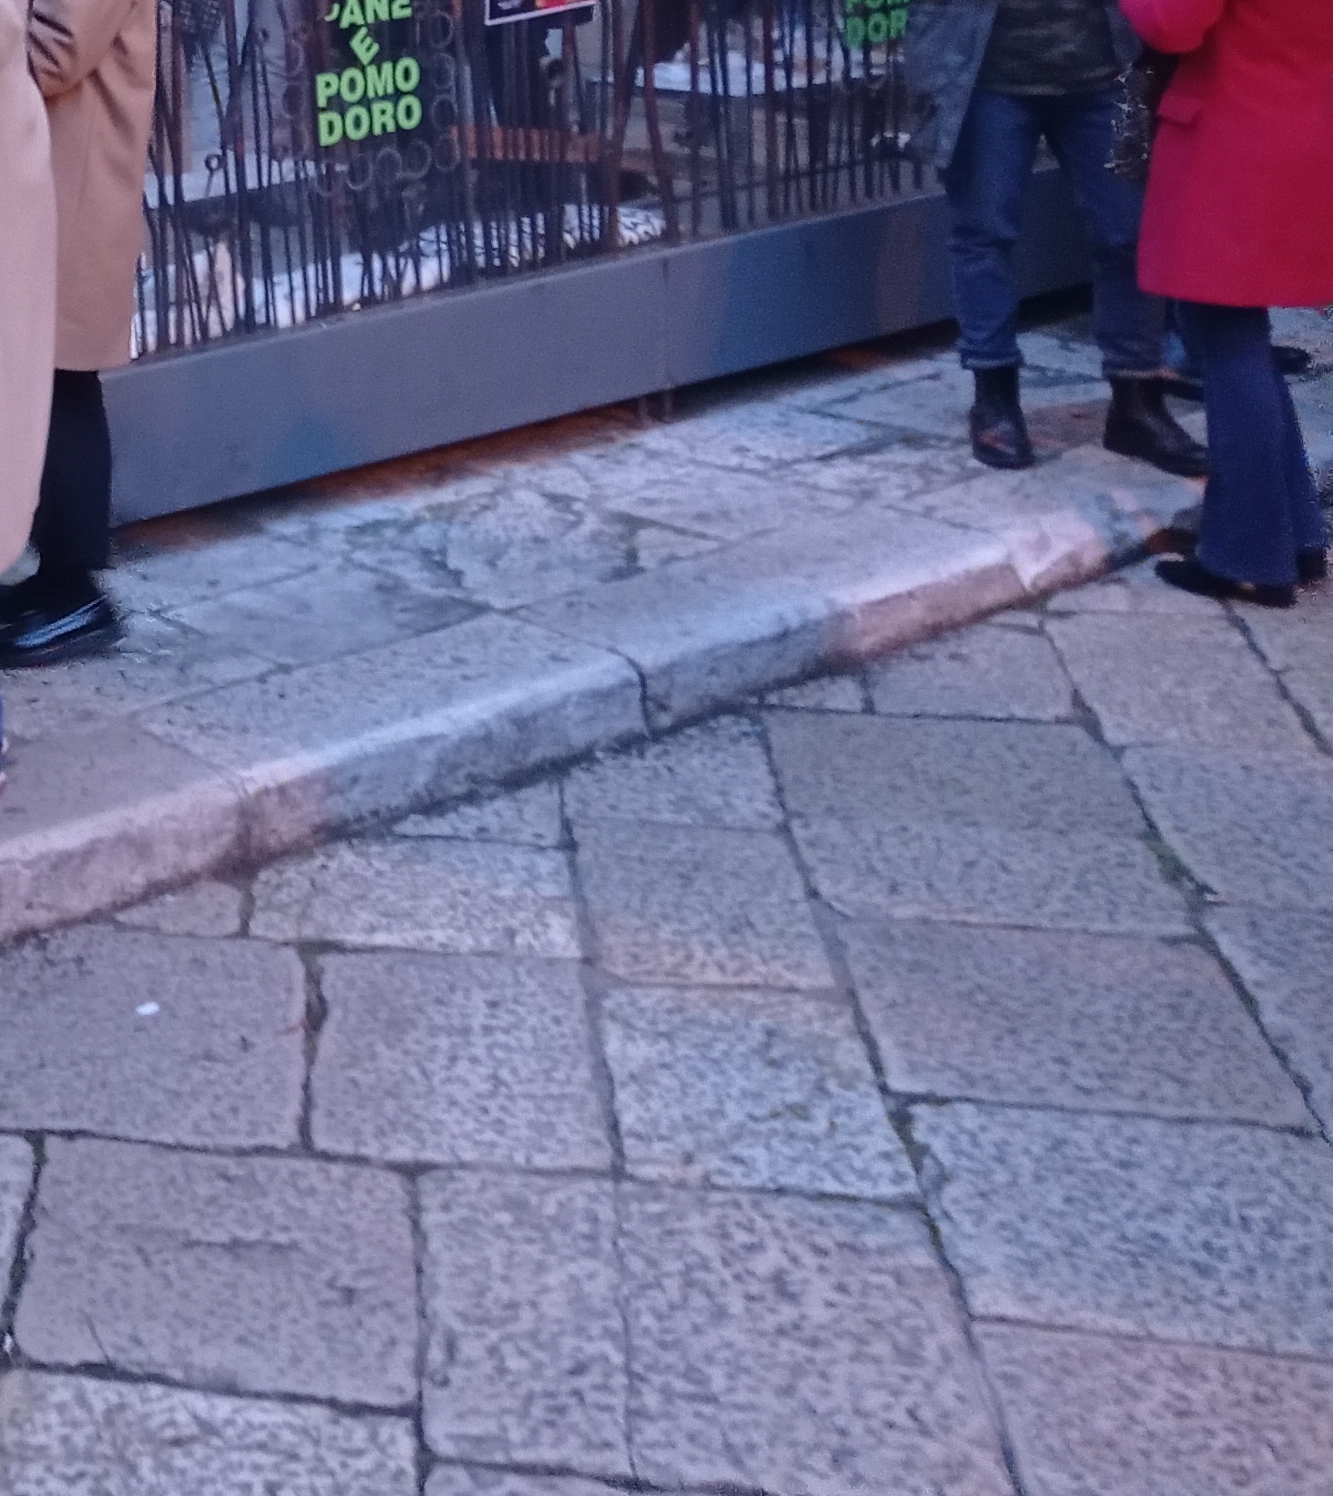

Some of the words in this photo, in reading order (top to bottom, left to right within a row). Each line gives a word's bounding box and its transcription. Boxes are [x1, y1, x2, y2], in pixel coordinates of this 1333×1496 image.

[846, 8, 909, 47] DOR
[316, 57, 421, 108] POMO
[318, 94, 423, 147] DORO
